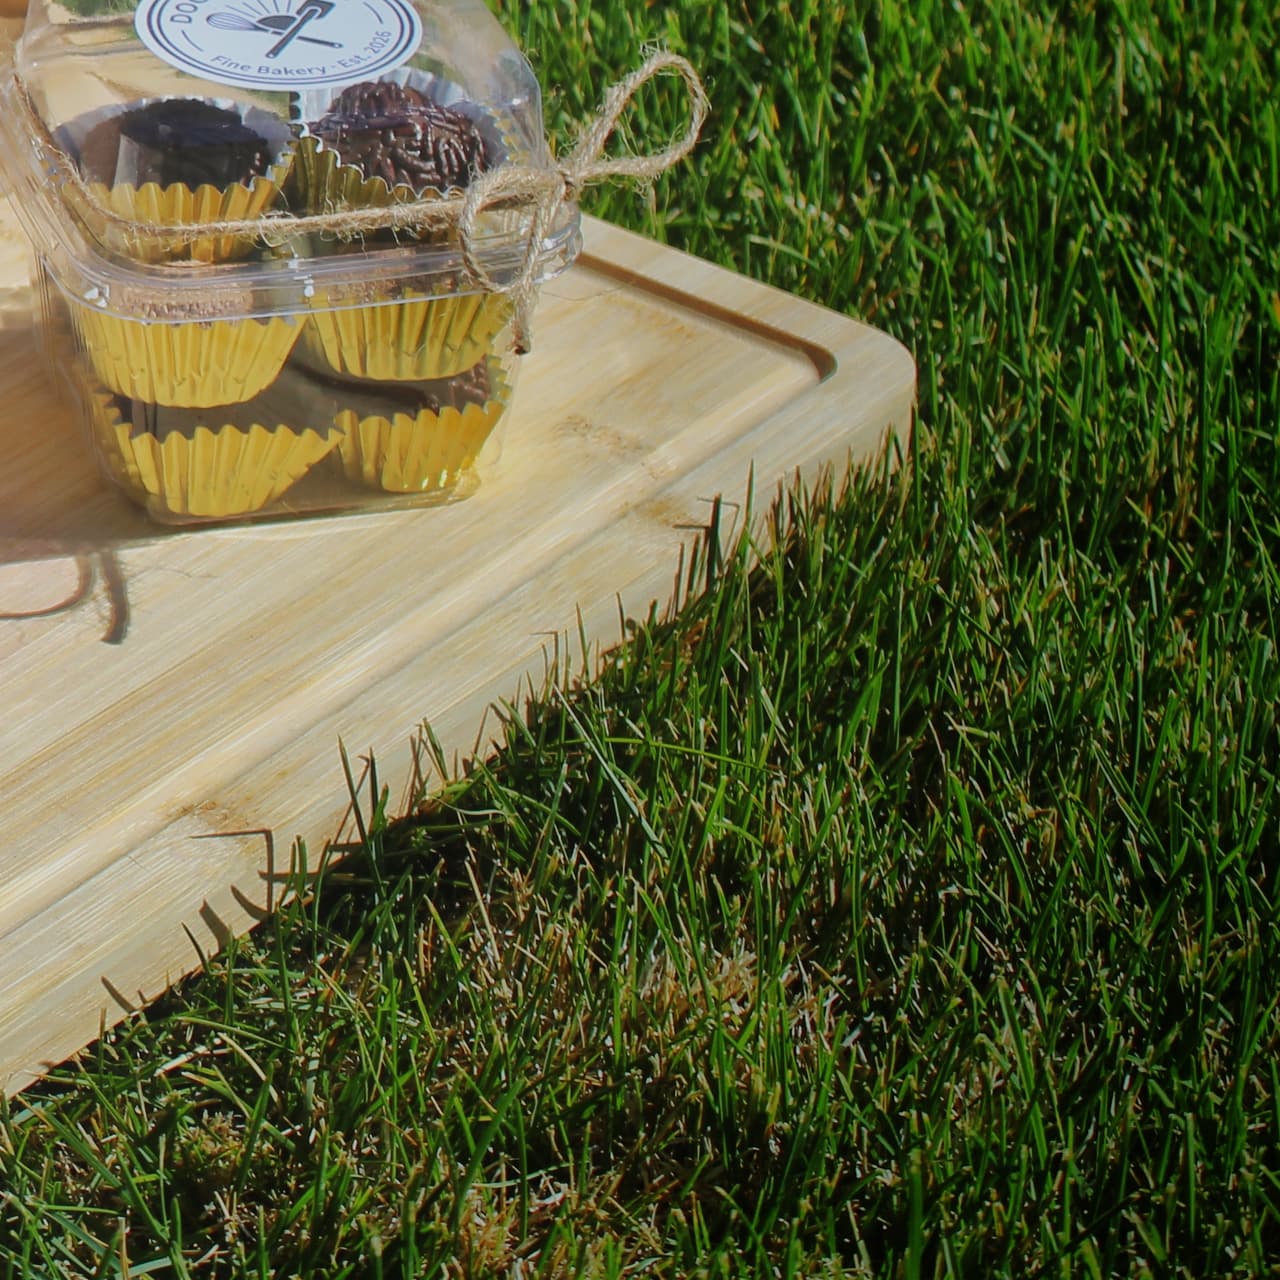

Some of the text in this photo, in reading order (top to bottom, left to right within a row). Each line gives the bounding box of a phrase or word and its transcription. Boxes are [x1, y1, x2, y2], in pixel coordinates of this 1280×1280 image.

[211, 30, 391, 77] Fine Bakery Est. 2026
